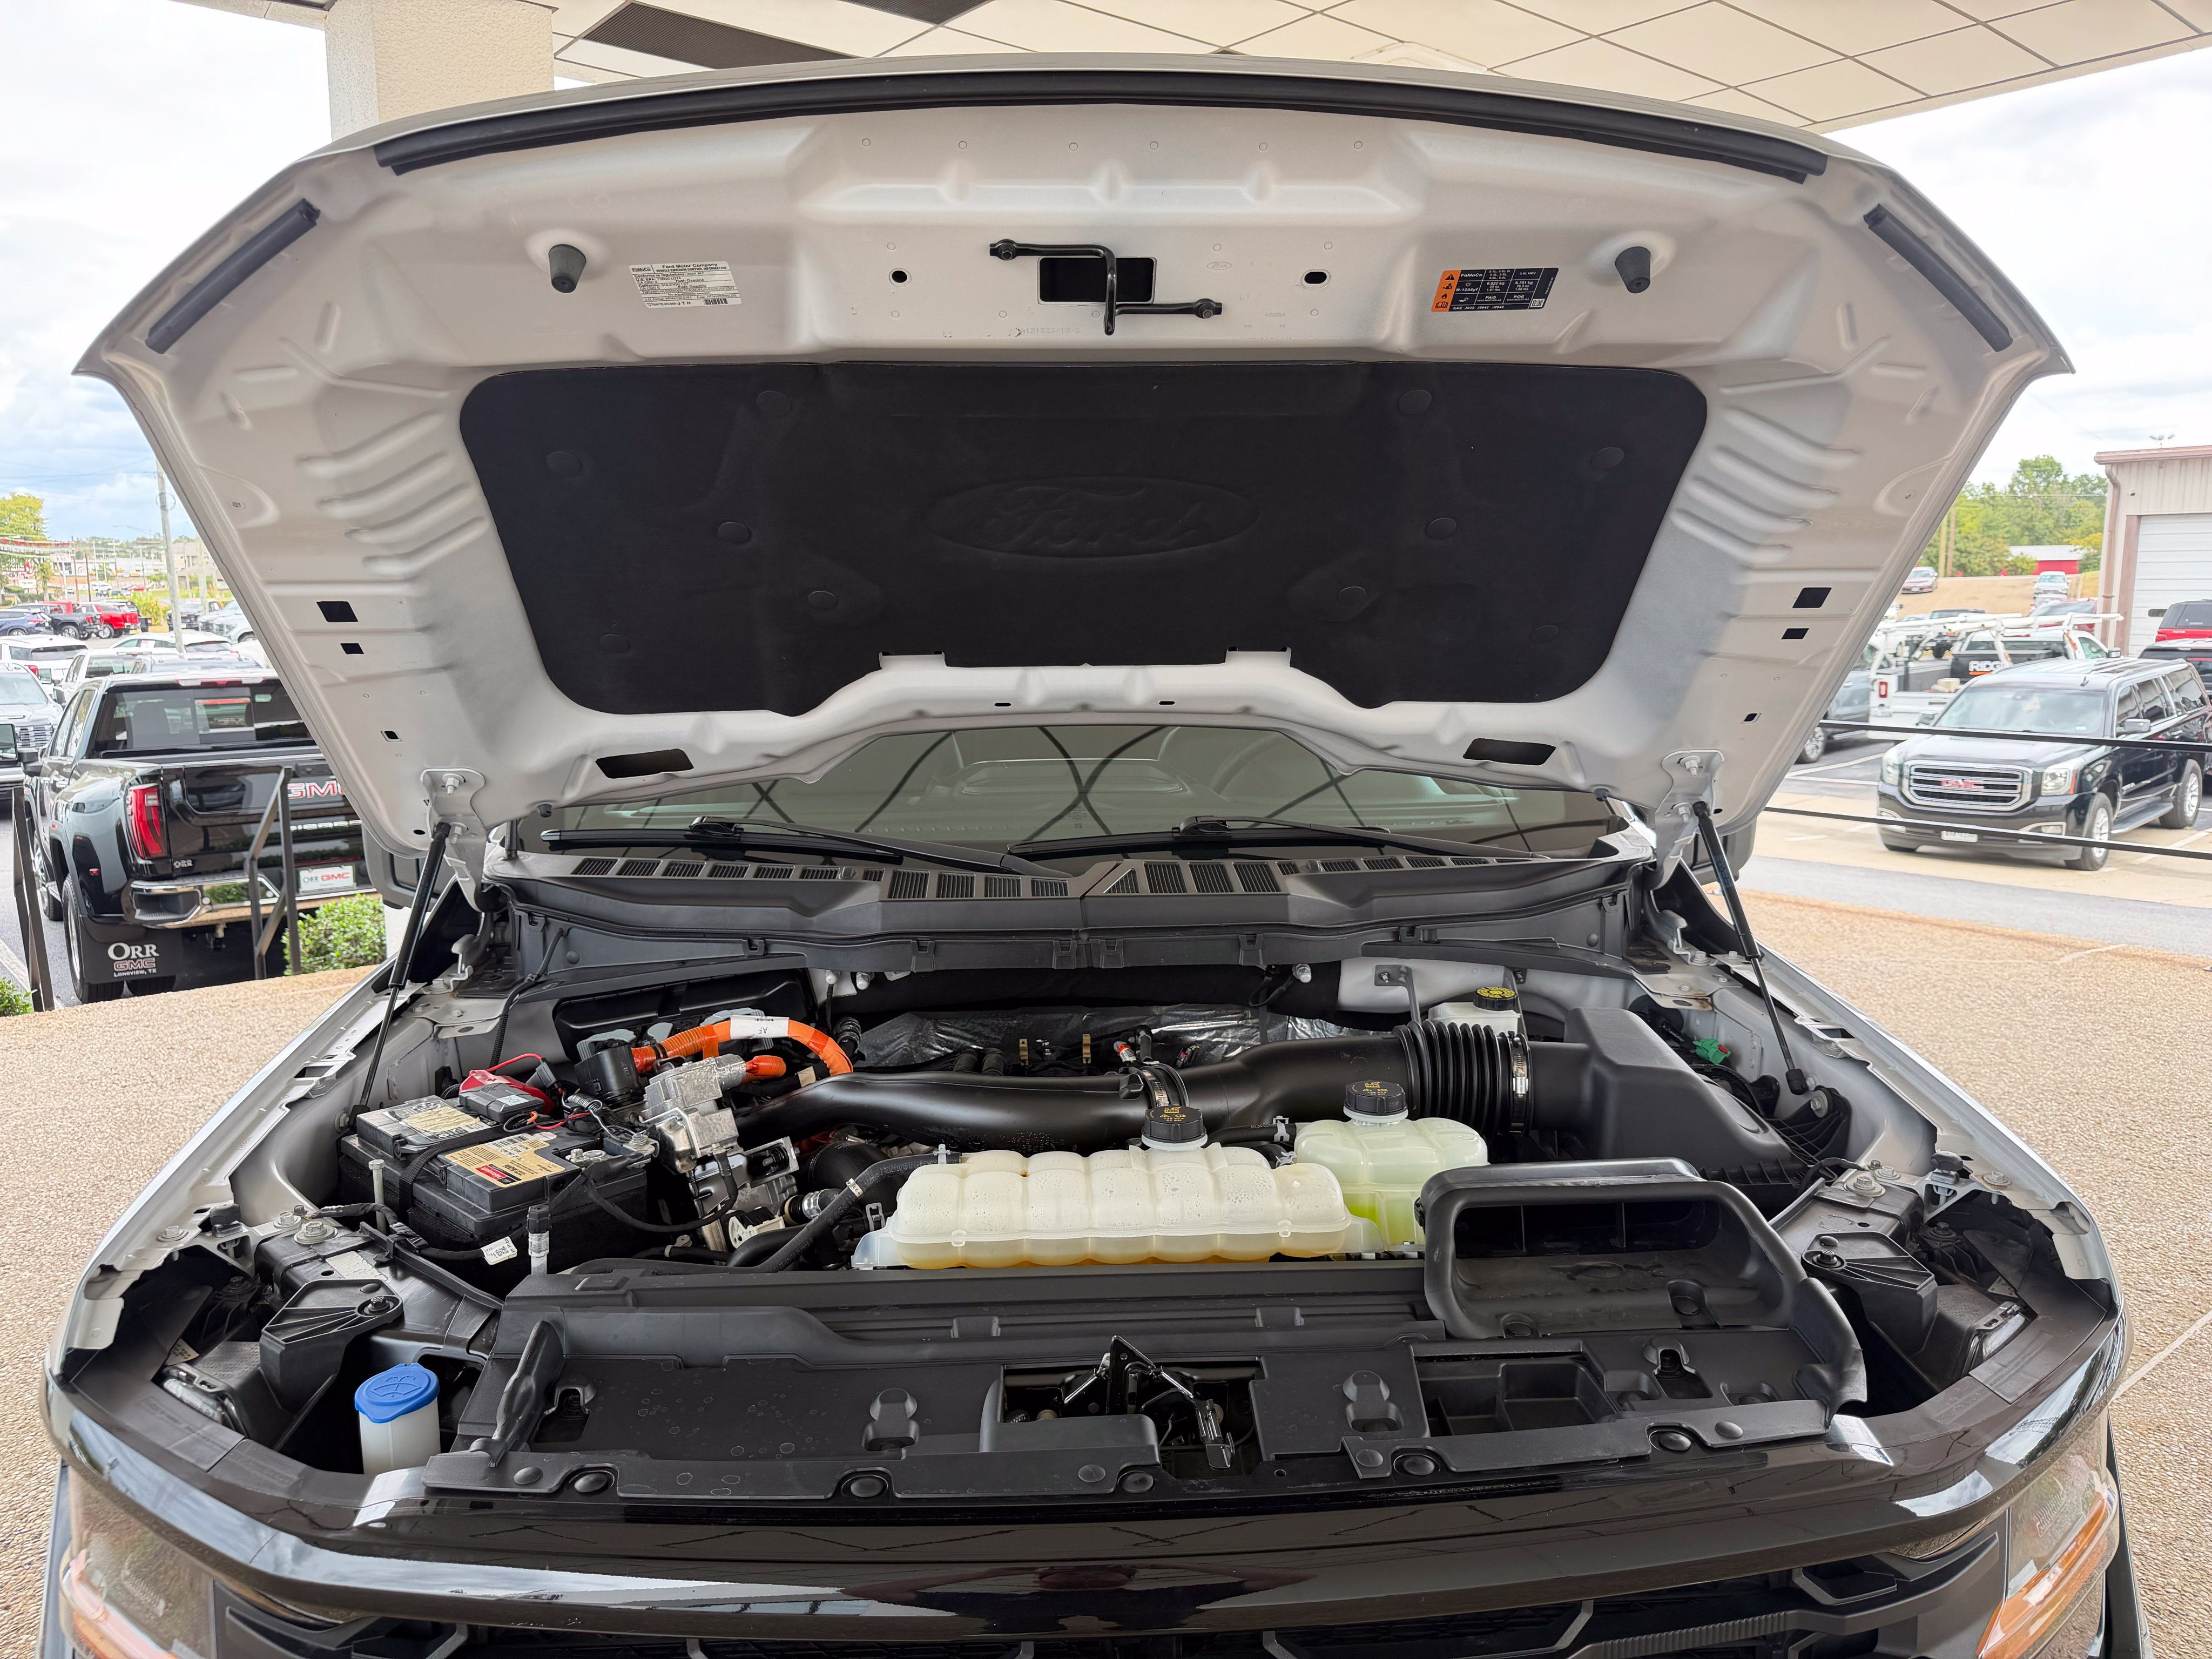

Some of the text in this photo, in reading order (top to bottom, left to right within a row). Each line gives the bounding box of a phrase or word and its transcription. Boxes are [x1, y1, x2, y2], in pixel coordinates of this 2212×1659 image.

[1969, 660, 2001, 671] RIDG
[1940, 778, 1984, 792] GMC
[173, 859, 193, 869] ORR
[303, 872, 350, 884] ORR GMC
[108, 942, 160, 961] ORR
[114, 957, 156, 972] GMC
[114, 969, 147, 977] LONGVIEW,
